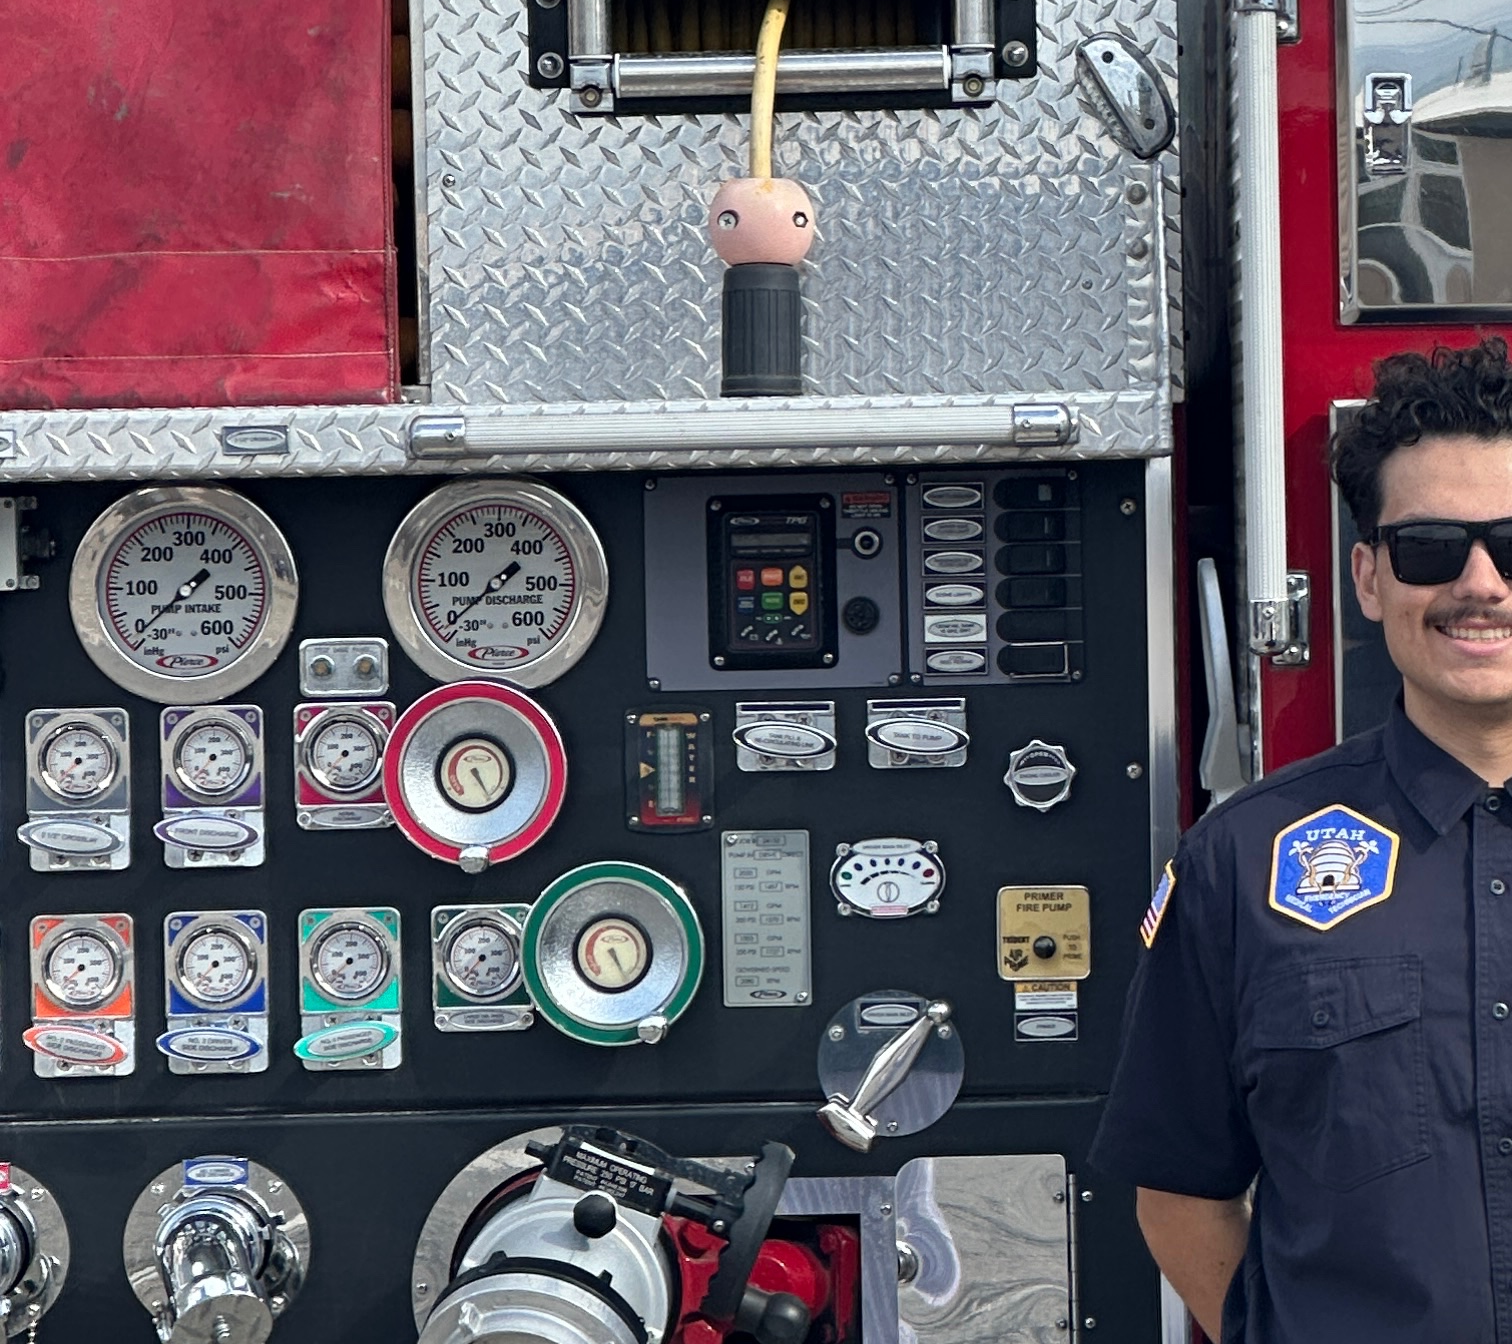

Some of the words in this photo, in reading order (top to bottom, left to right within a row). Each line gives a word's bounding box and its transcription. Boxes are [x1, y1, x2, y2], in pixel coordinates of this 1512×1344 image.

[483, 522, 516, 538] 300
[172, 531, 205, 546] 300
[452, 538, 485, 554] 200
[510, 540, 543, 556] 400
[141, 547, 173, 562] 200
[200, 549, 233, 564] 400
[438, 571, 470, 587] 100
[525, 576, 558, 591] 500
[126, 580, 158, 596] 100
[214, 585, 247, 600] 500
[452, 596, 483, 606] PUMP
[485, 595, 544, 606] DISCHARGE
[151, 605, 182, 615] PUMP
[185, 604, 222, 614] INTAKE
[446, 610, 458, 625] 0
[512, 611, 544, 626] 600
[134, 619, 146, 633] 0
[201, 620, 234, 635] 600
[215, 645, 230, 655] psi
[526, 637, 541, 647] psi
[1306, 827, 1366, 842] UTAH
[1024, 892, 1064, 901] PRIMER
[1016, 903, 1040, 912] FIRE
[1042, 903, 1072, 912] PUMP
[562, 1155, 598, 1175] PRESSURE
[638, 1184, 655, 1196] BAR
[576, 1151, 608, 1168] MAXIMUM
[609, 1164, 648, 1184] OPERATING
